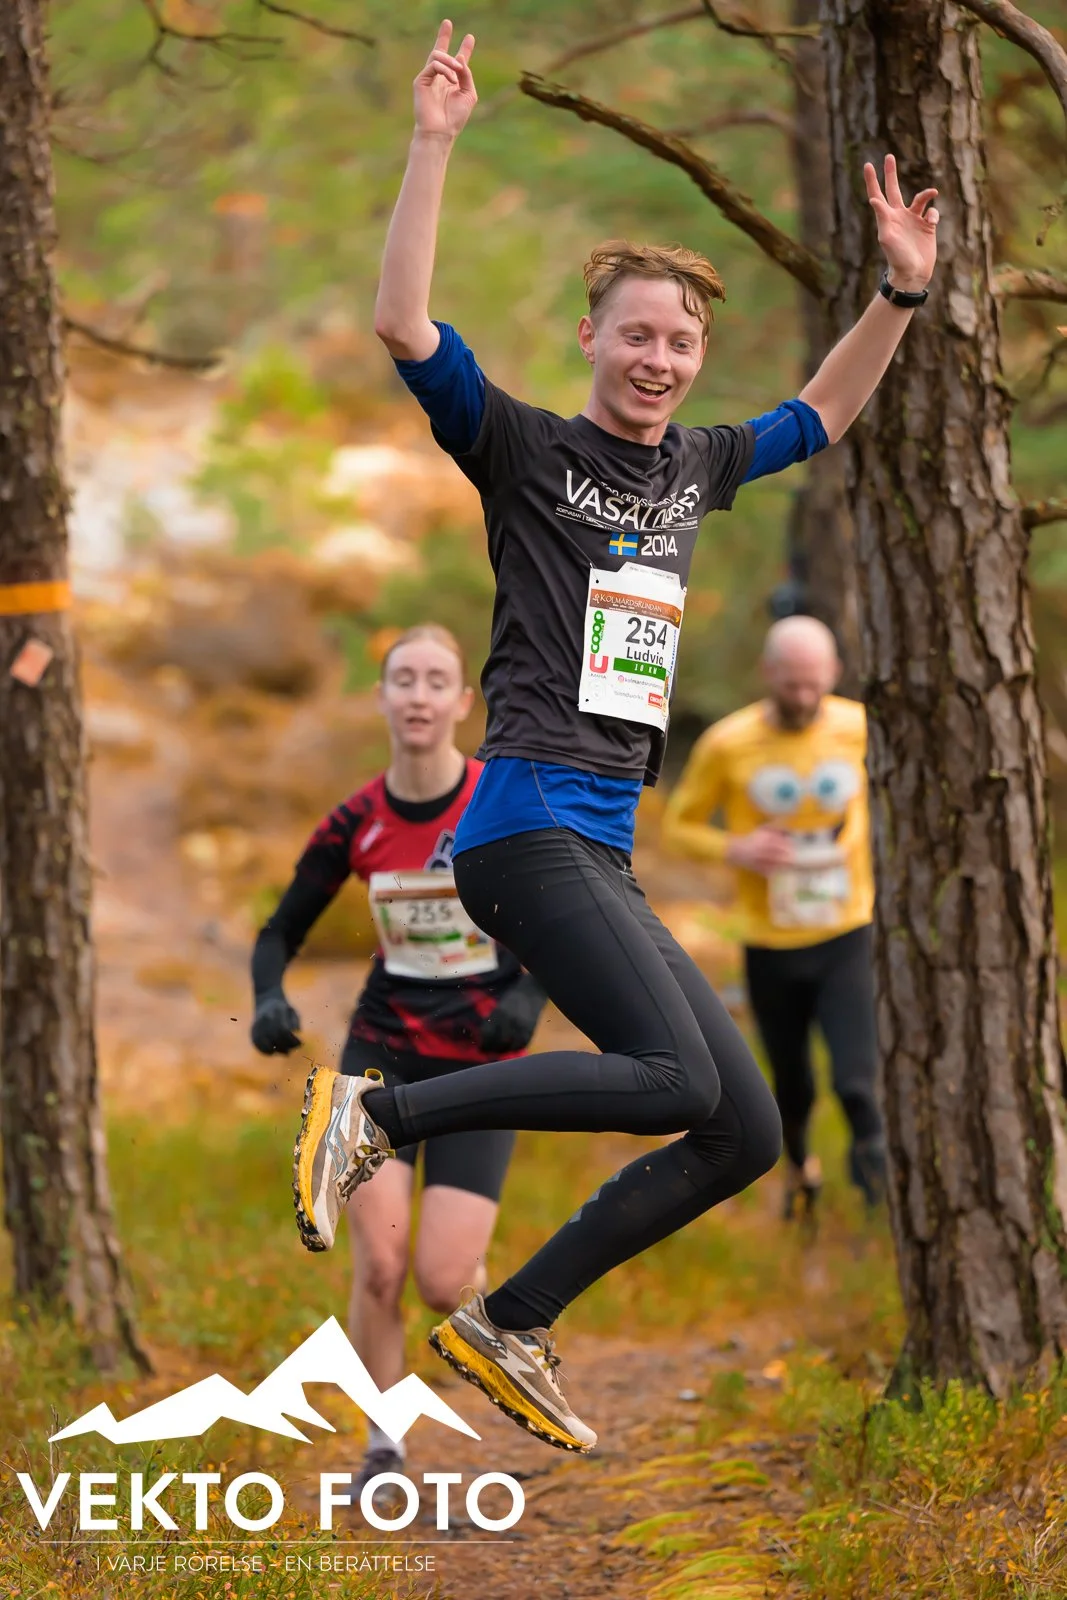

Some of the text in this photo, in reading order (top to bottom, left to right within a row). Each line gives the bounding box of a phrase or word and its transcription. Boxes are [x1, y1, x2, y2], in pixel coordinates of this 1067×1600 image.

[641, 535, 678, 557] 2014
[590, 610, 606, 654] coop
[625, 616, 668, 650] 254
[626, 646, 664, 669] Ludvig
[407, 902, 454, 925] 255
